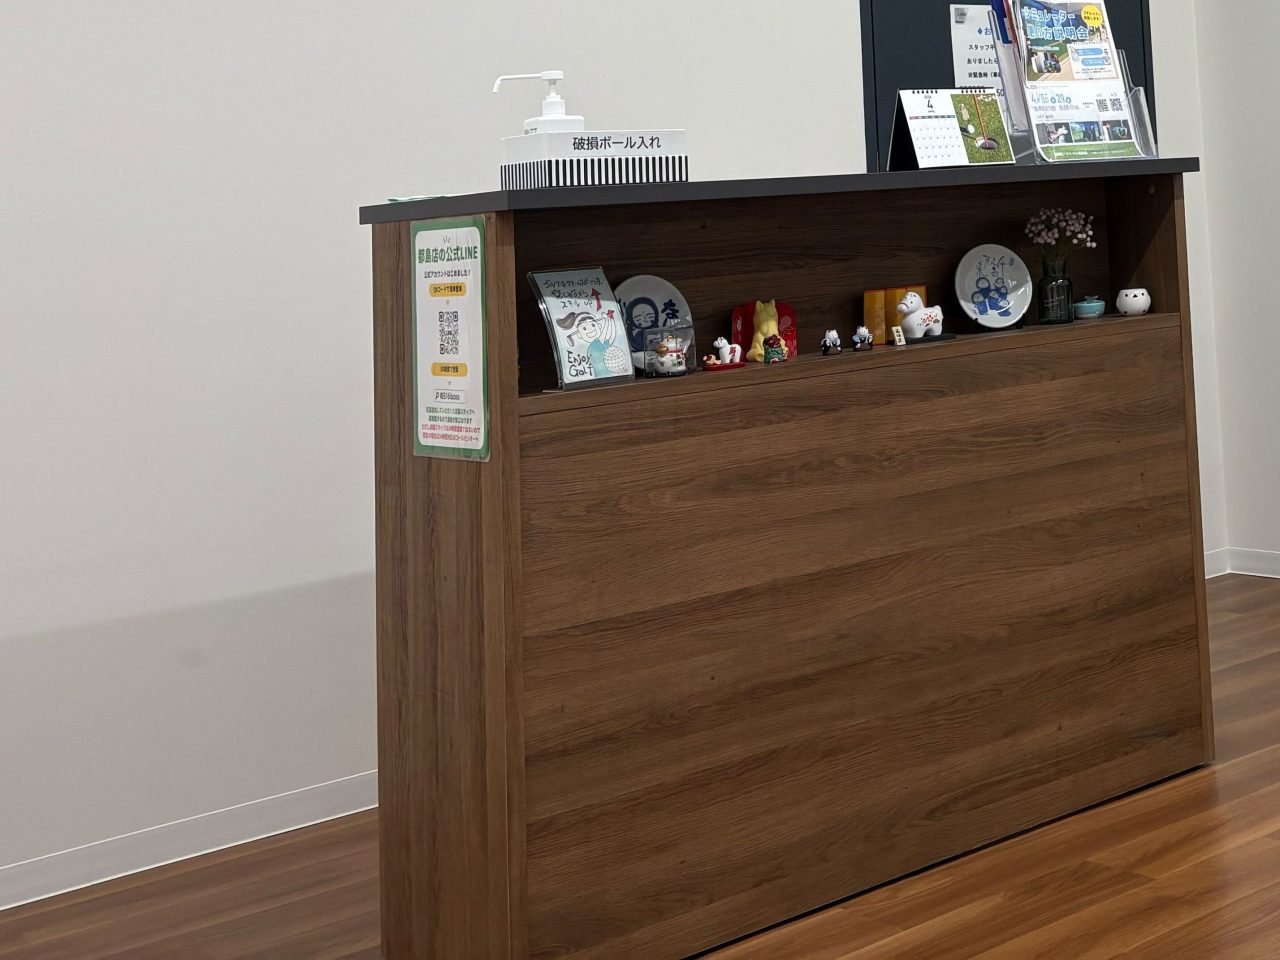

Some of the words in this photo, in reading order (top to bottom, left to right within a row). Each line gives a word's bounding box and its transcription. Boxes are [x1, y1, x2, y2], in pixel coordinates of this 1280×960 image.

[573, 136, 661, 150] 破損ボール入れ
[418, 245, 477, 263] 都島店の公式LINE
[567, 349, 593, 367] Enjoy
[568, 364, 594, 378] Golf
